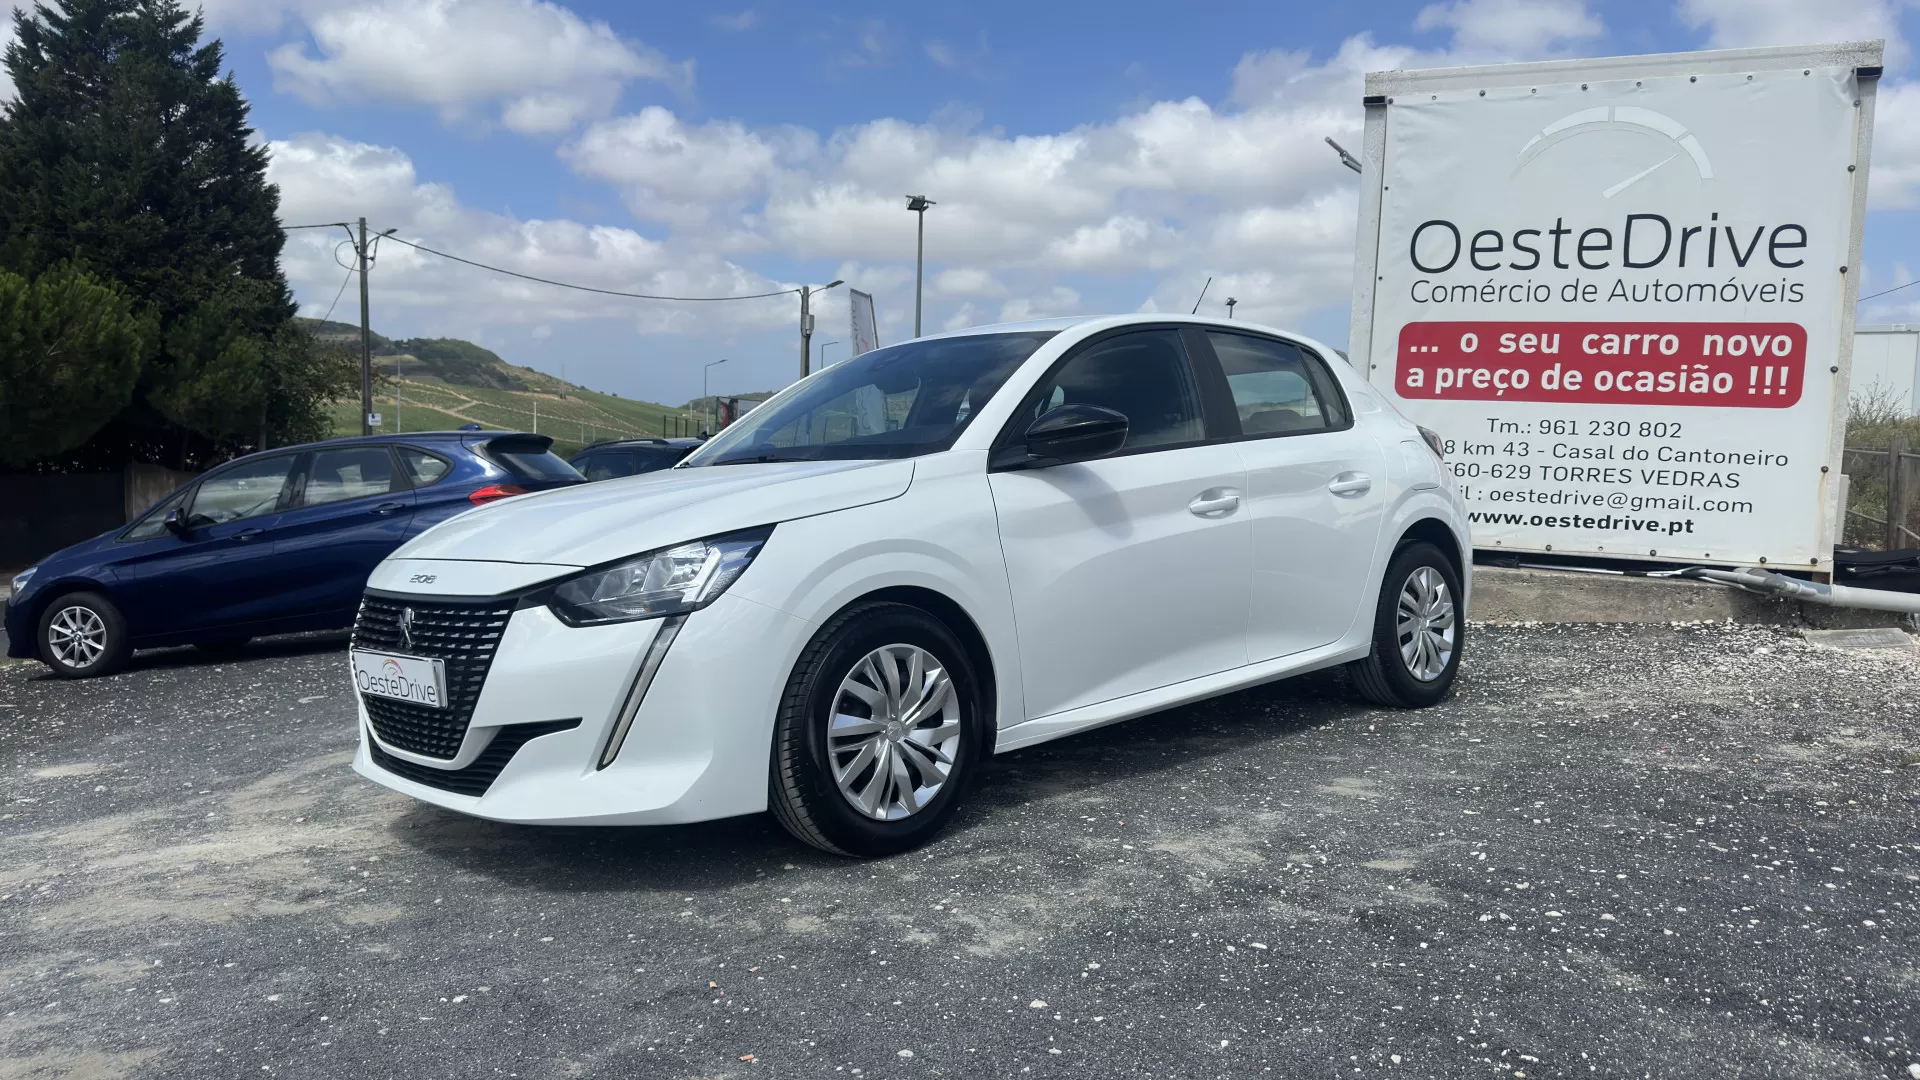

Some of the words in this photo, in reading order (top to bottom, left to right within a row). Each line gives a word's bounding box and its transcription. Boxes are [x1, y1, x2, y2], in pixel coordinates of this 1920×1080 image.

[1409, 212, 1808, 274] OesteDrive
[1410, 278, 1551, 304] Comércio
[1560, 277, 1598, 303] de
[1607, 276, 1804, 303] Automóveis
[1460, 332, 1479, 353] o
[1498, 332, 1560, 354] seu
[1582, 333, 1679, 356] carro
[1702, 334, 1793, 357] novo
[1406, 367, 1425, 388] a
[1435, 367, 1530, 398] preço
[1541, 362, 1583, 391] de
[1594, 363, 1734, 394] ocasião
[1748, 365, 1789, 395] !!!
[1486, 417, 1531, 434] Tm.:
[1539, 419, 1579, 436] 961
[1588, 420, 1631, 437] 230
[1638, 421, 1682, 439] 802
[1463, 440, 1495, 456] km
[1502, 441, 1529, 457] 43
[1552, 443, 1615, 460] Casal
[1622, 445, 1649, 461] do
[1657, 446, 1789, 467] Cantoneiro
[1539, 465, 1632, 484] TORRES
[1640, 469, 1740, 489] VEDRAS
[1489, 489, 1754, 514] oestedrive@gmail.com
[1467, 512, 1695, 536] www.oestedrive.pt
[358, 669, 437, 703] OesteDrive
